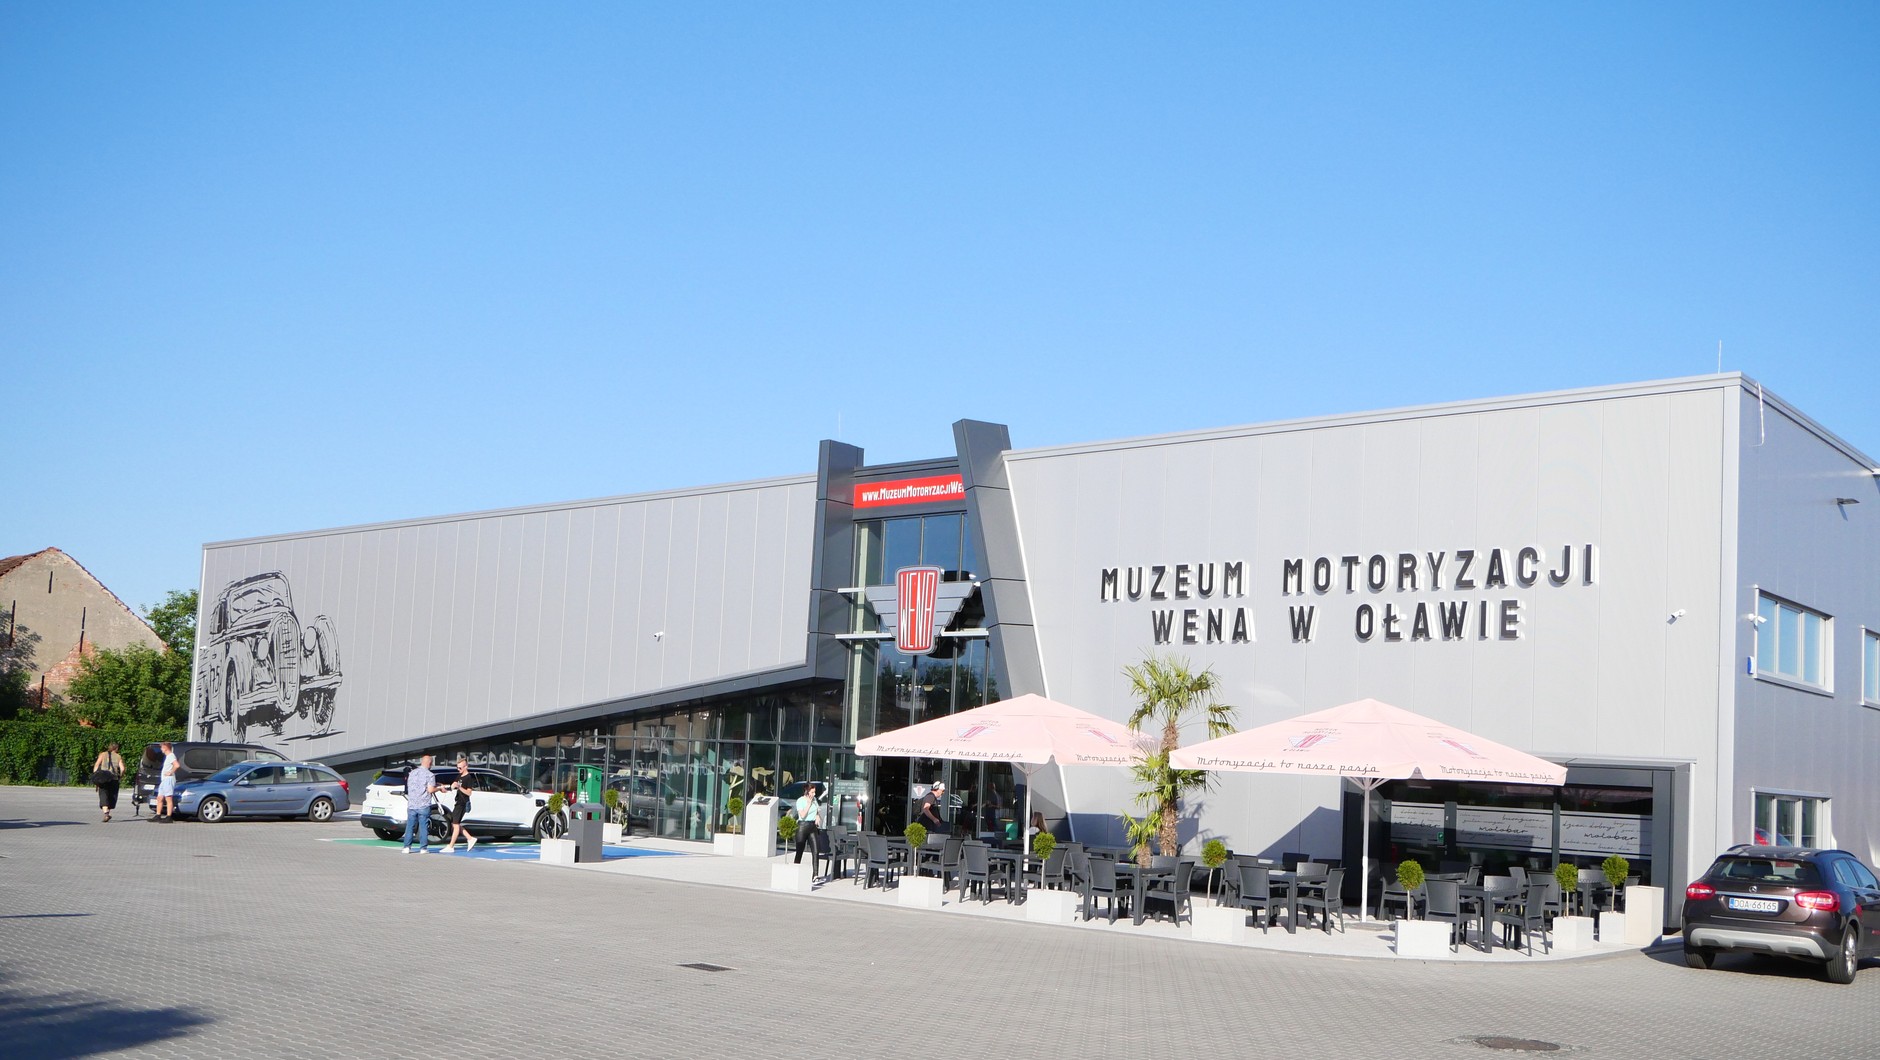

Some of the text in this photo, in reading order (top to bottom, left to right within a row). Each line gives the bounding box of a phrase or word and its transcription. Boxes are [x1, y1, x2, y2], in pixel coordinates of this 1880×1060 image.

[1101, 543, 1594, 600] MUZEUM MOTORYZACJI
[900, 572, 936, 648] WENA
[1151, 599, 1521, 644] WENA W OŁAWIE
[943, 747, 956, 755] to
[958, 749, 990, 758] nasza
[990, 750, 1024, 760] pasja
[1196, 756, 1381, 776] Motoryzacja to nasza pasja
[1752, 901, 1777, 911] 66165
